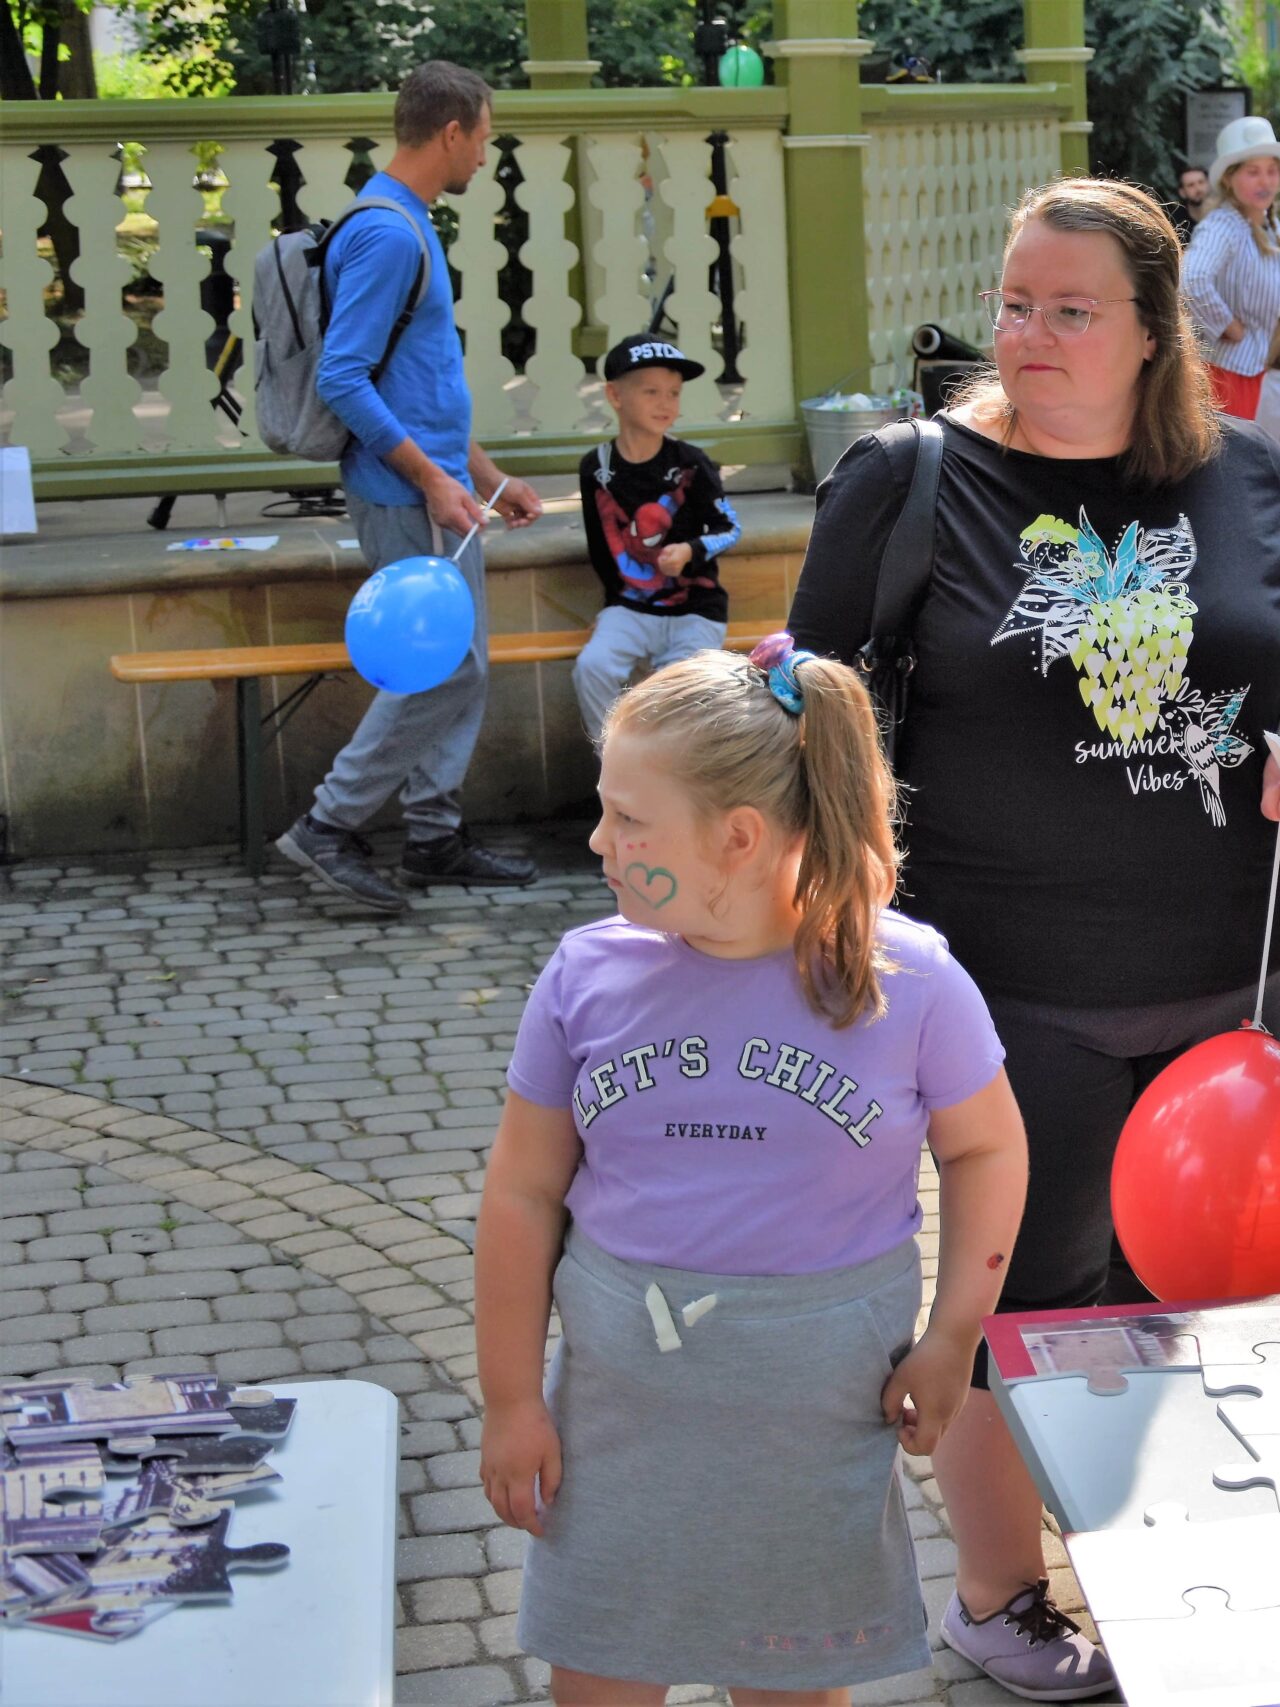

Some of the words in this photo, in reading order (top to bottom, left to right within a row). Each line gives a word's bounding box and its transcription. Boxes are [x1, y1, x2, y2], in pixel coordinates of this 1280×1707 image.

[1126, 764, 1188, 795] Vibes
[573, 1035, 709, 1129] LET'S
[737, 1036, 884, 1149] CHILL
[664, 1123, 768, 1142] EVERYDAY
